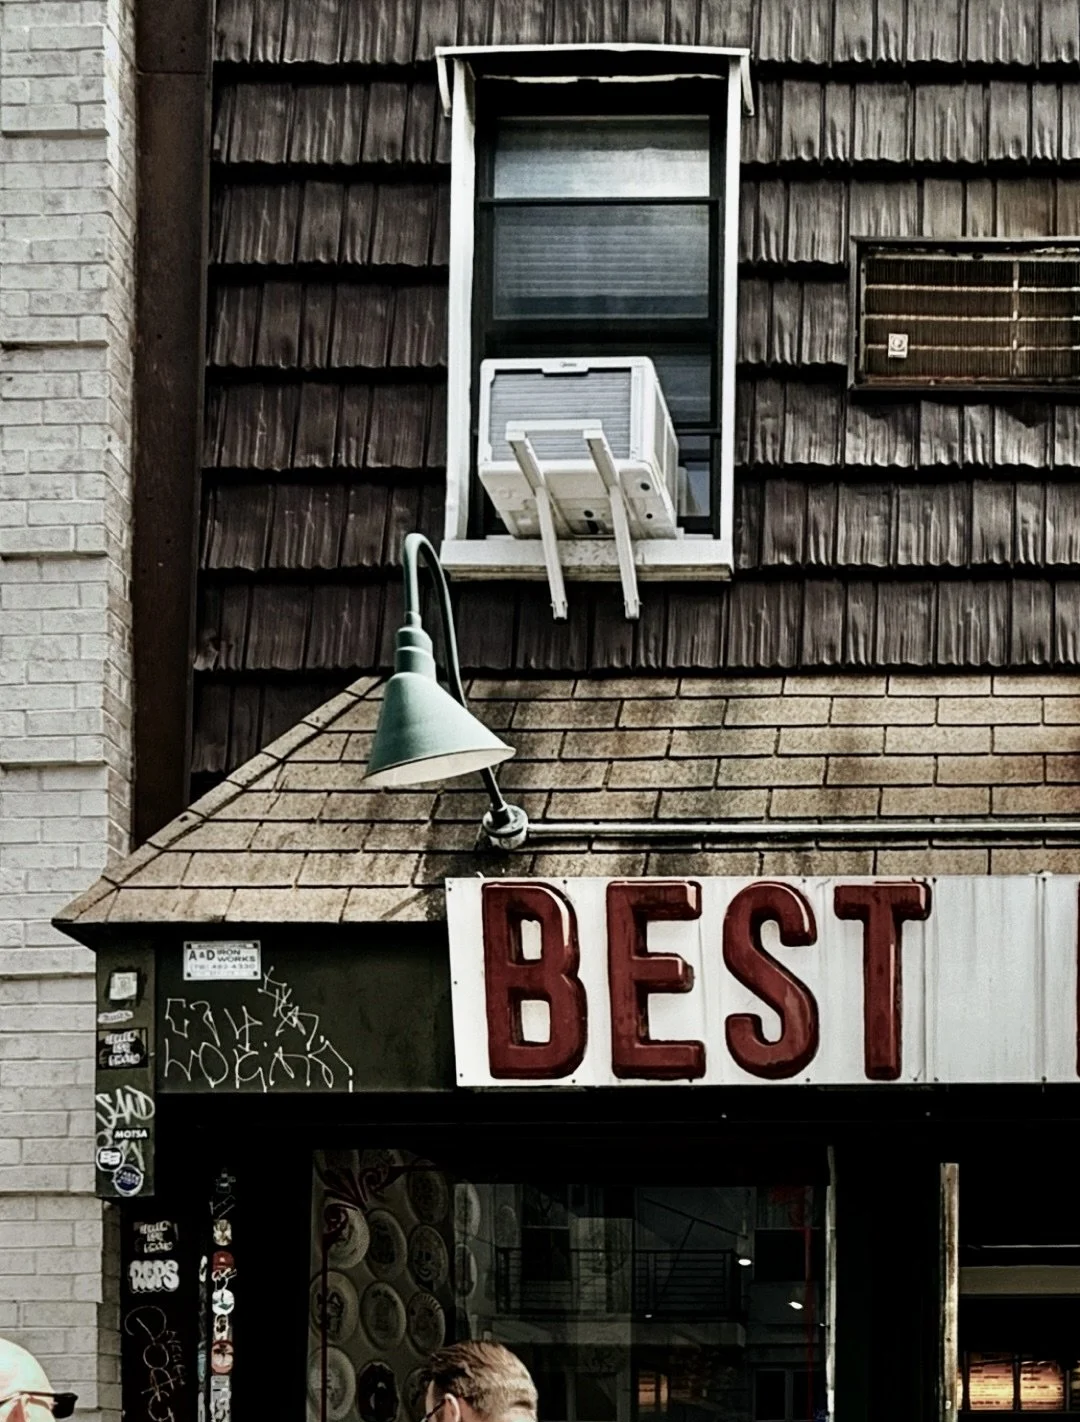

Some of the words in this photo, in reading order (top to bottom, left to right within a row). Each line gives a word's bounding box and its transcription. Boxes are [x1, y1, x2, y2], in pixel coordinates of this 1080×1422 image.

[189, 950, 197, 961] A
[206, 949, 216, 961] D
[481, 880, 932, 1081] BEST
